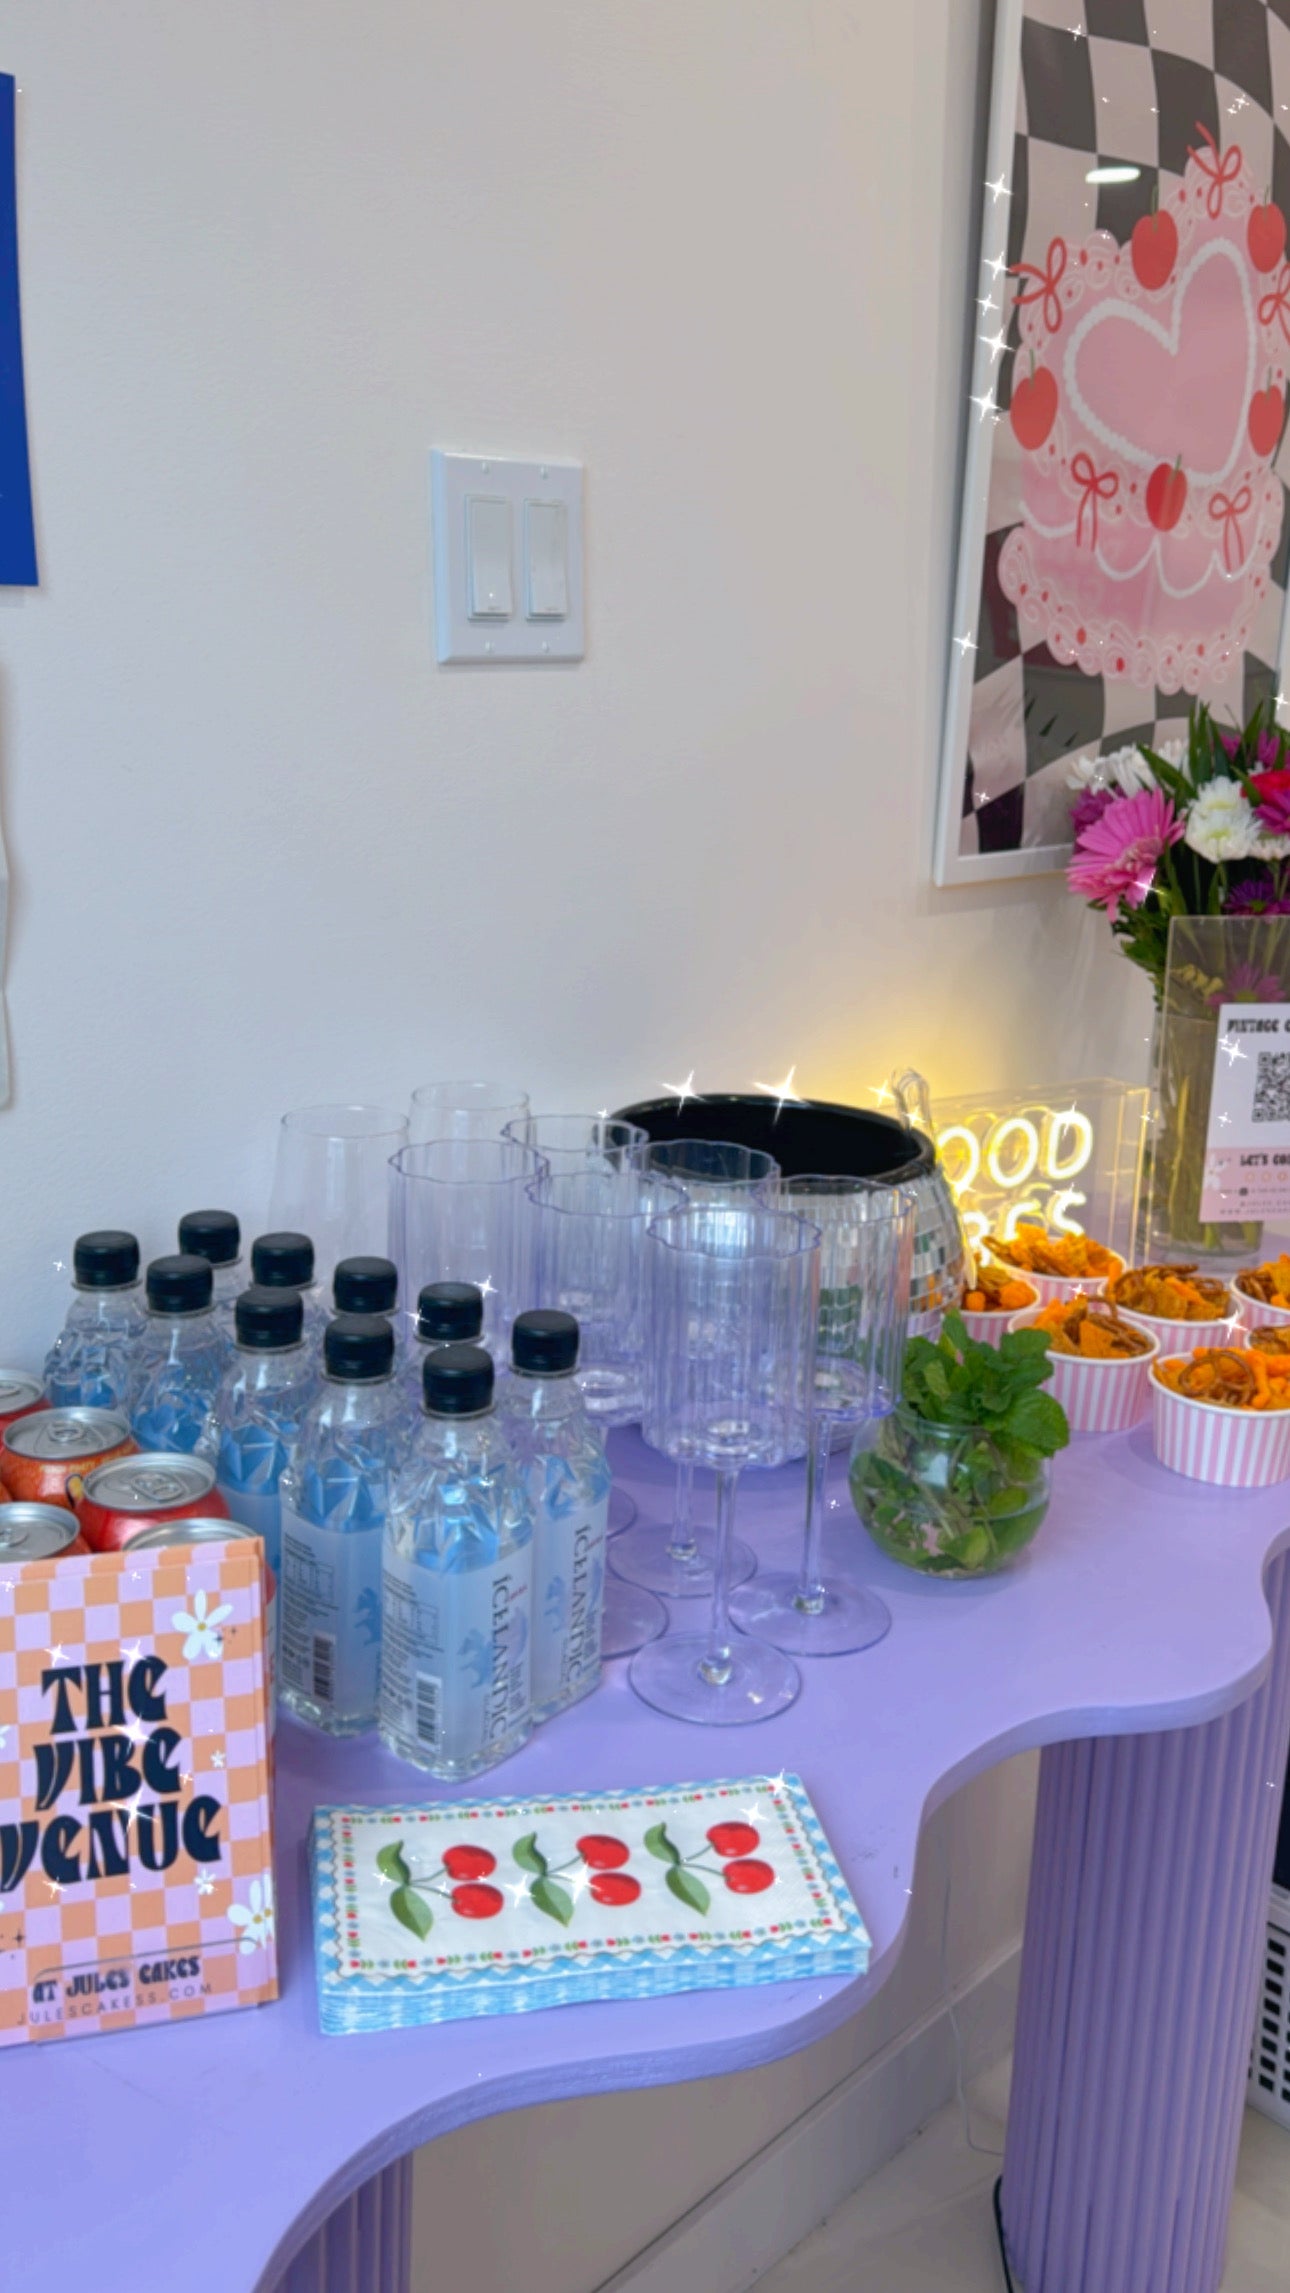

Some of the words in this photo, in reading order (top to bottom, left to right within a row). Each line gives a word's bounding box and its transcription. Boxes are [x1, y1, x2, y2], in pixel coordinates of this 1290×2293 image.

[937, 1110, 1093, 1190] OOD
[567, 1523, 592, 1683] ICELANDIC
[41, 1655, 168, 1735] THE
[489, 1574, 512, 1740] ICELANDIC
[33, 1727, 182, 1812] VIBE
[0, 1795, 222, 1894] VENUE
[17, 1983, 212, 2026] JULESCAKESS.COM
[32, 1980, 57, 2004] AT
[66, 1968, 130, 1998] JULES
[139, 1955, 201, 1985] CAKES
